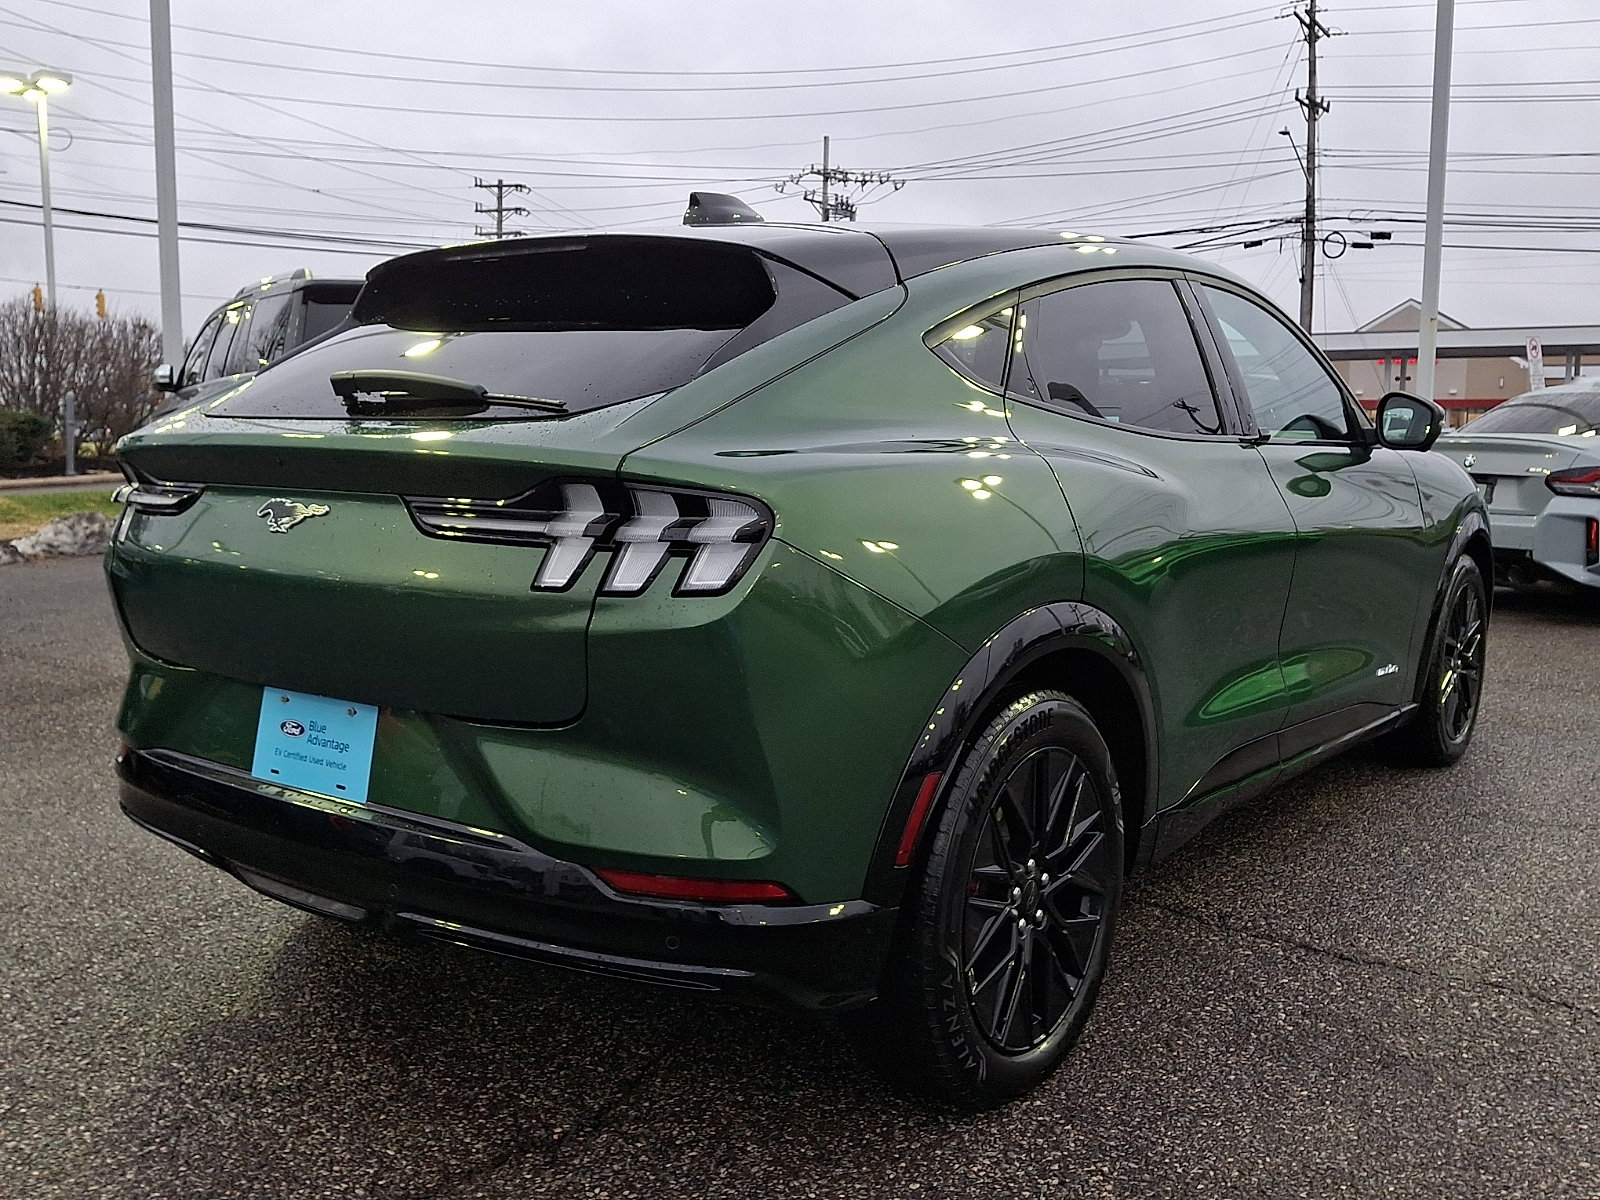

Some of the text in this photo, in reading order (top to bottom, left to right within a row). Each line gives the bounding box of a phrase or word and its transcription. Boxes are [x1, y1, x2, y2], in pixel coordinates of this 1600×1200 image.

[281, 720, 304, 737] Ford
[308, 720, 326, 734] Blue
[306, 733, 350, 753] Advantage
[274, 747, 347, 771] EV Certified Used Vehicle
